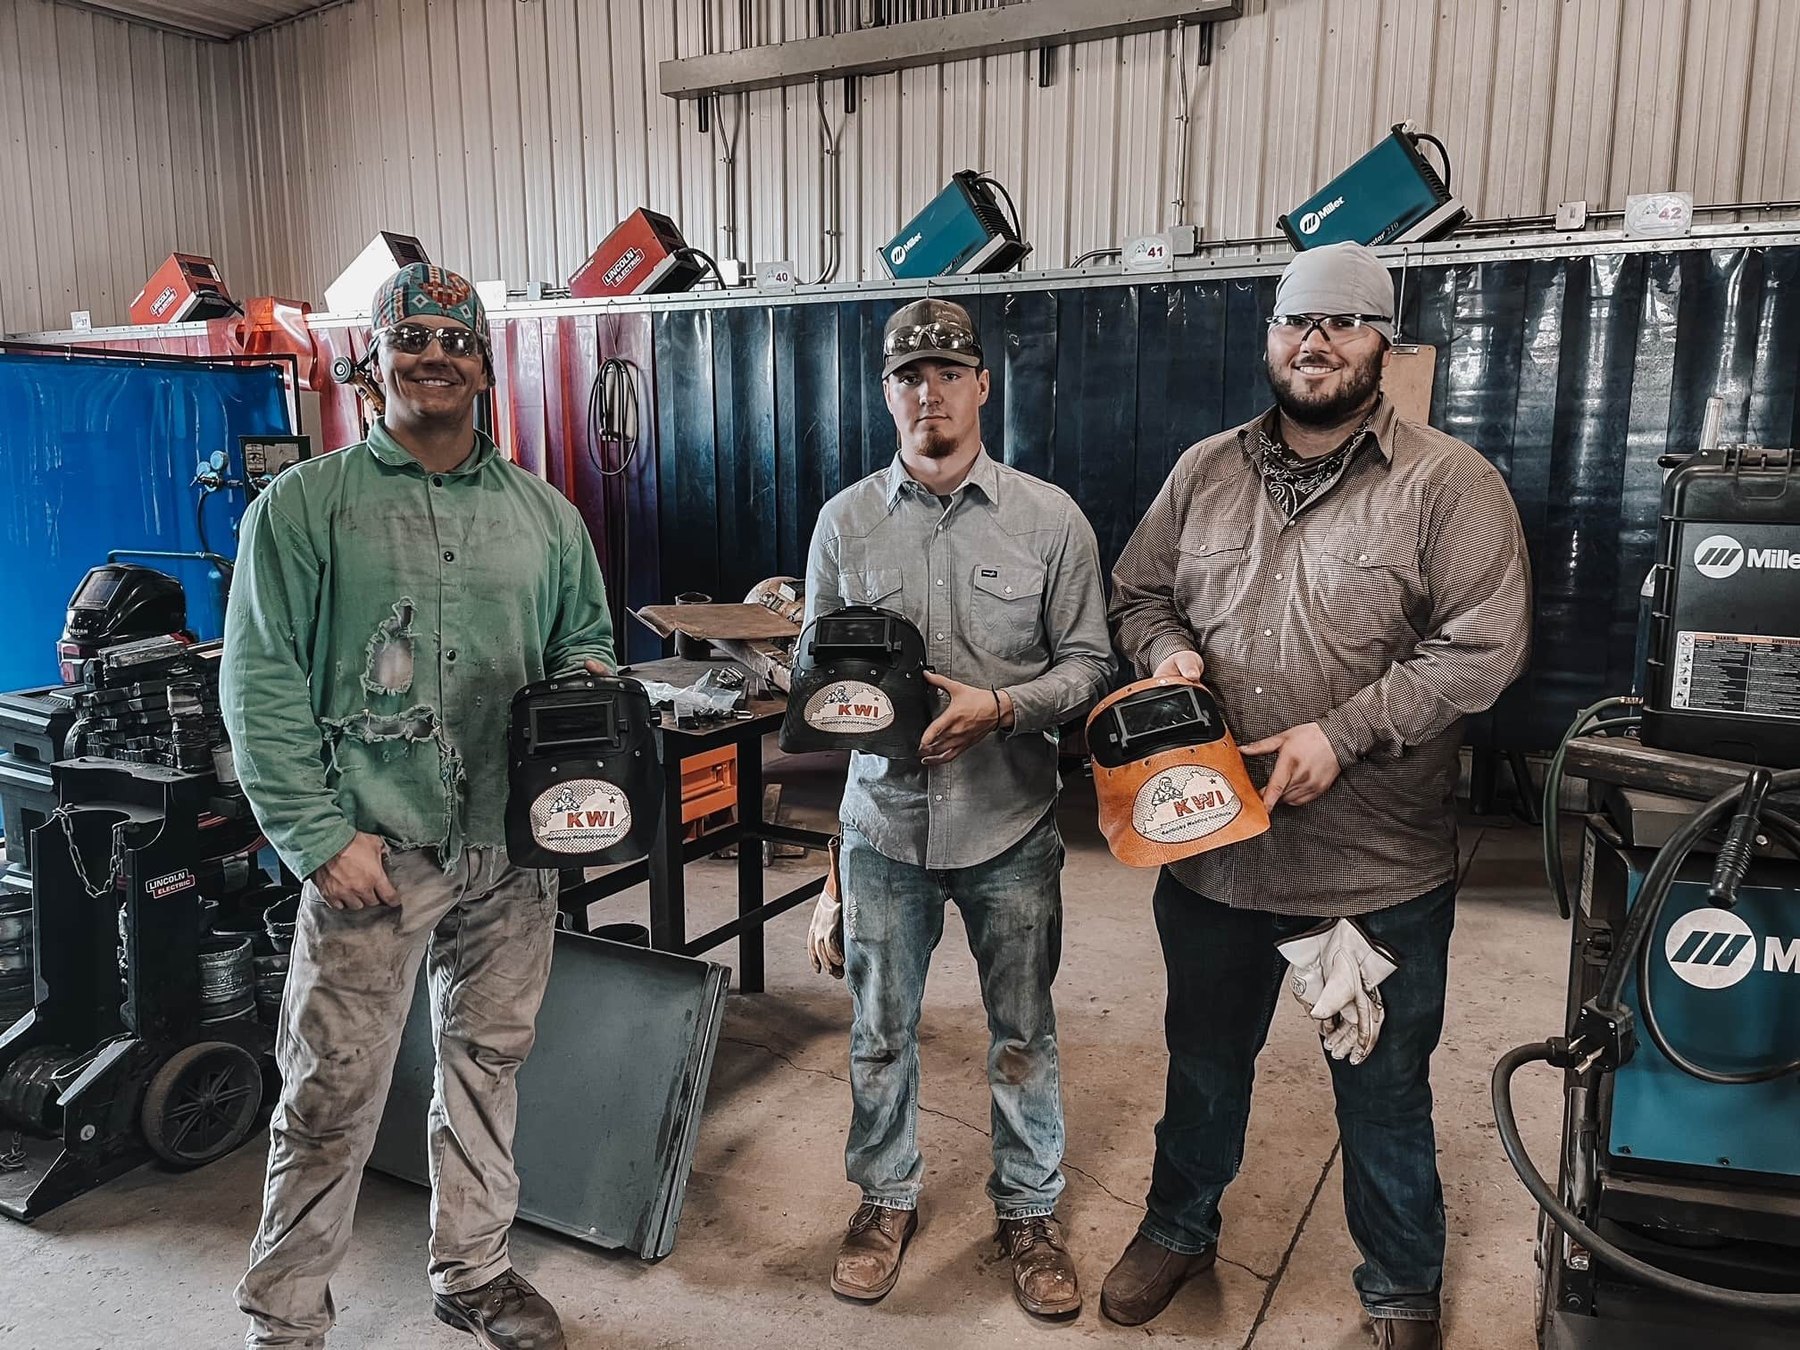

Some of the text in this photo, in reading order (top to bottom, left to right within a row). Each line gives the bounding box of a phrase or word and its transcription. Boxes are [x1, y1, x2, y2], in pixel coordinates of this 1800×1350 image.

[1318, 196, 1345, 220] Miller
[1659, 206, 1682, 220] 42
[903, 232, 922, 252] Miller
[1147, 246, 1163, 258] 41
[604, 250, 636, 283] LINCOLN
[614, 255, 642, 284] ELECTRIC
[775, 272, 788, 282] 40
[1747, 549, 1800, 570] Mille
[838, 704, 879, 718] KWI
[1173, 790, 1225, 818] KWI
[566, 811, 615, 829] KWI
[150, 872, 185, 890] LINCOLN
[158, 879, 191, 895] ELECTRIC
